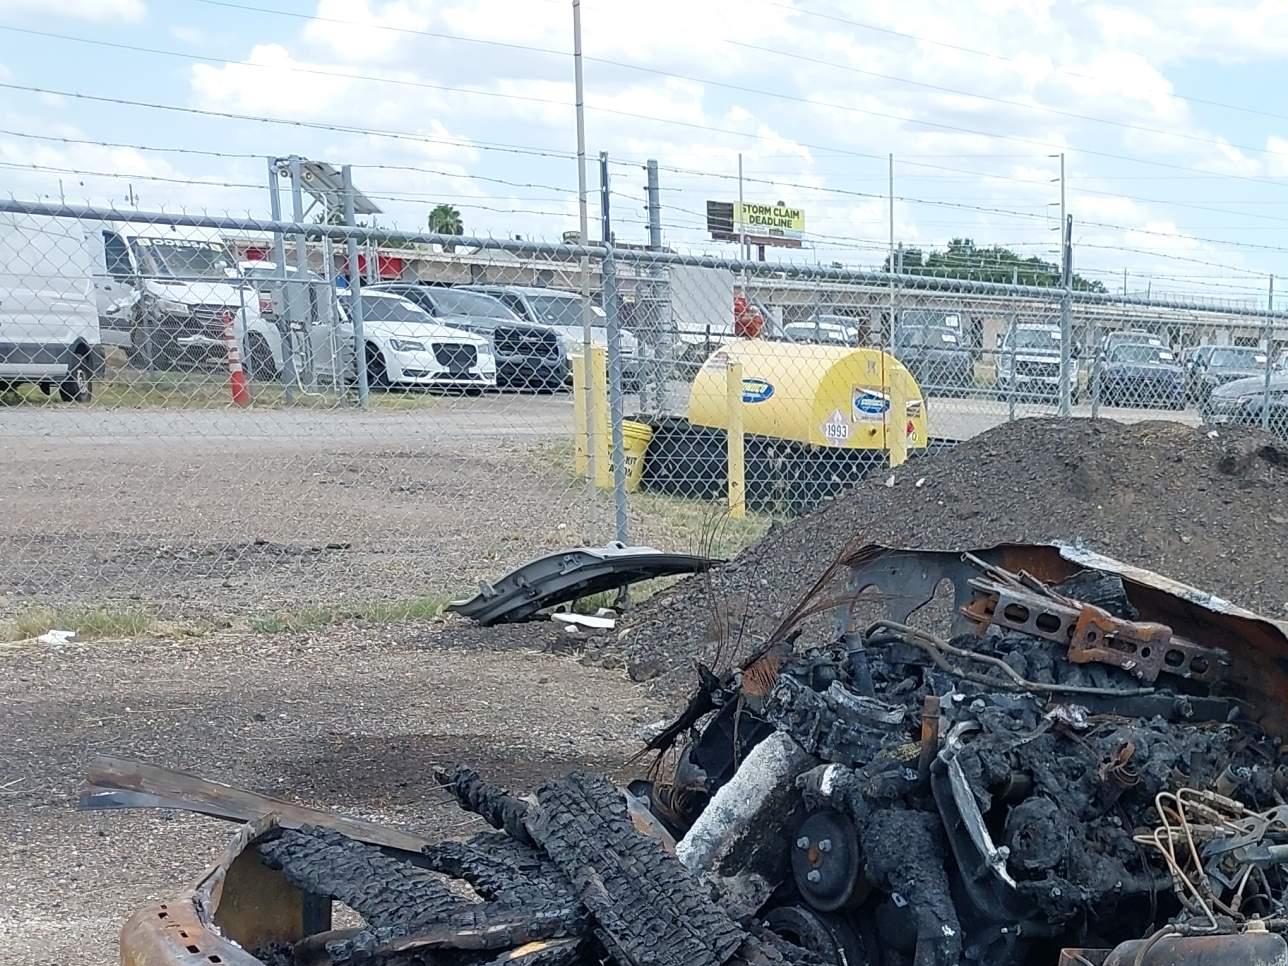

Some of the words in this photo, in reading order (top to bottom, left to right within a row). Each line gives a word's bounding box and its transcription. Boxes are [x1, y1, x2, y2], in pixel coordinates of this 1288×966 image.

[743, 204, 772, 216] STORM
[773, 207, 800, 219] CLAIM
[749, 215, 793, 228] DEADLINE
[827, 423, 847, 438] 1993
